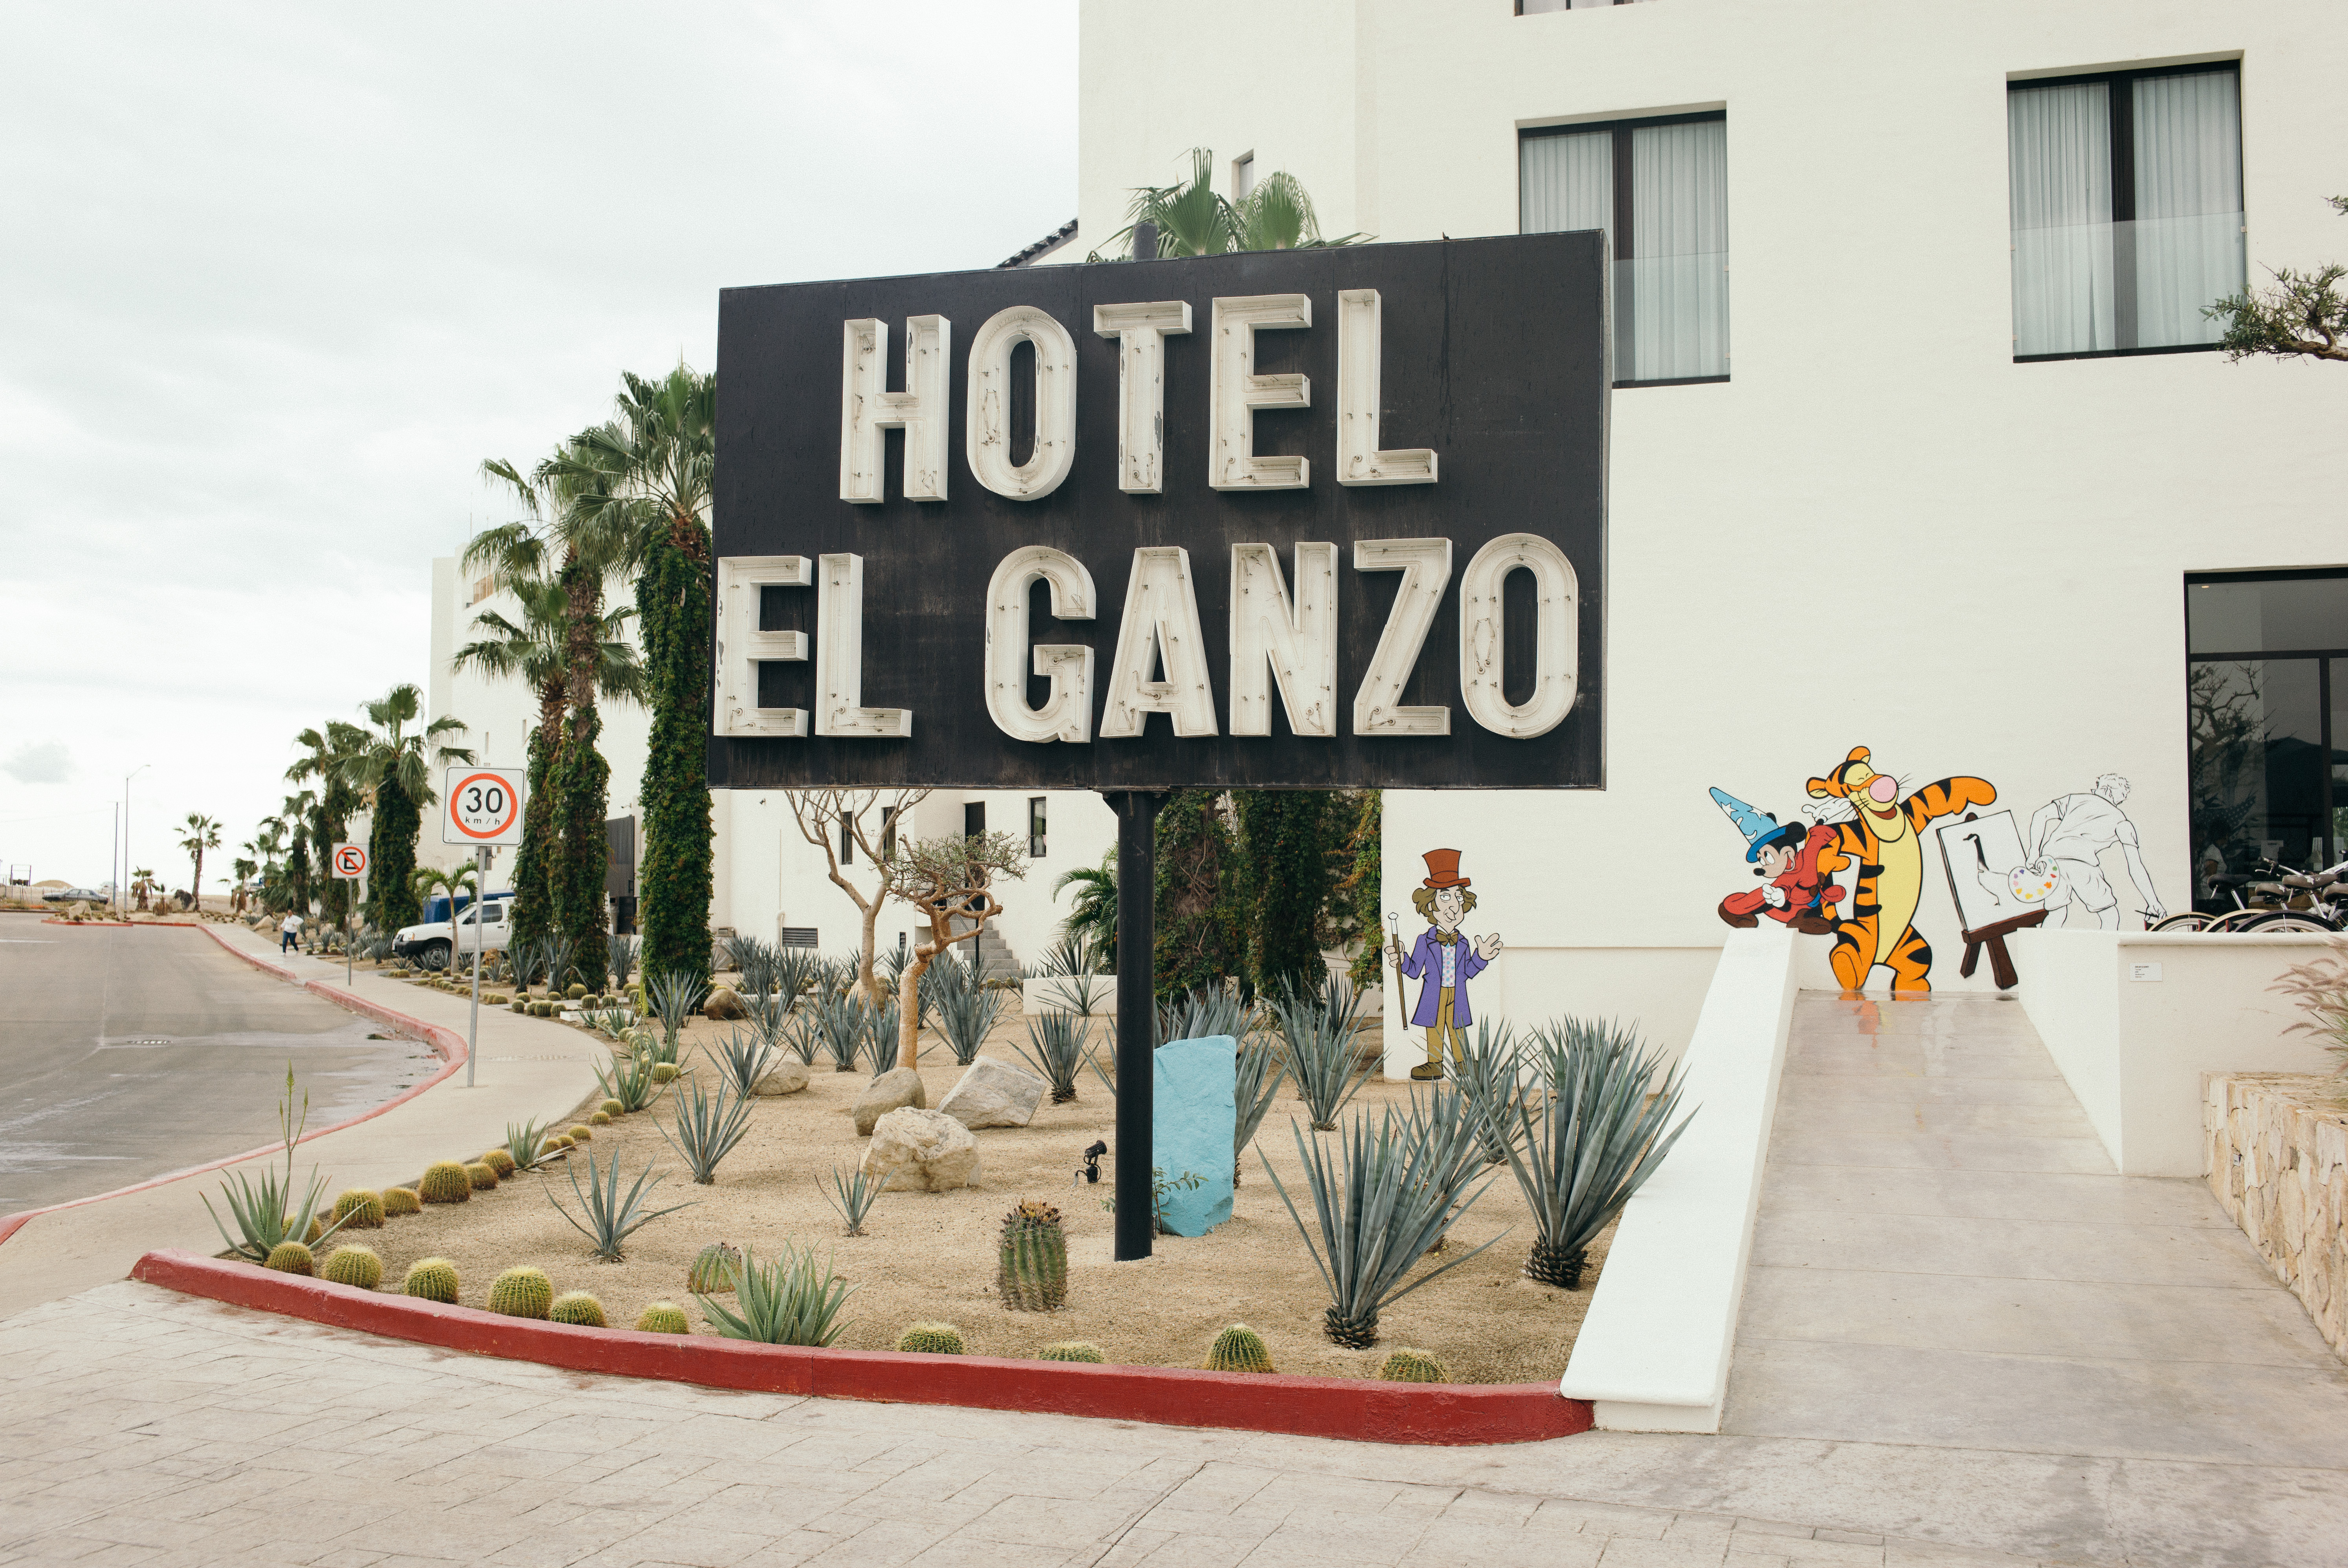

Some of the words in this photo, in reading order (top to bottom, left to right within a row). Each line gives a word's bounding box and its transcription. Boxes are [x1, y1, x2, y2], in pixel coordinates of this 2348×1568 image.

[840, 289, 1438, 504] HOTEL
[714, 553, 912, 737] EL
[984, 533, 1579, 743] GANZO
[466, 787, 503, 813] 30
[344, 852, 357, 869] E
